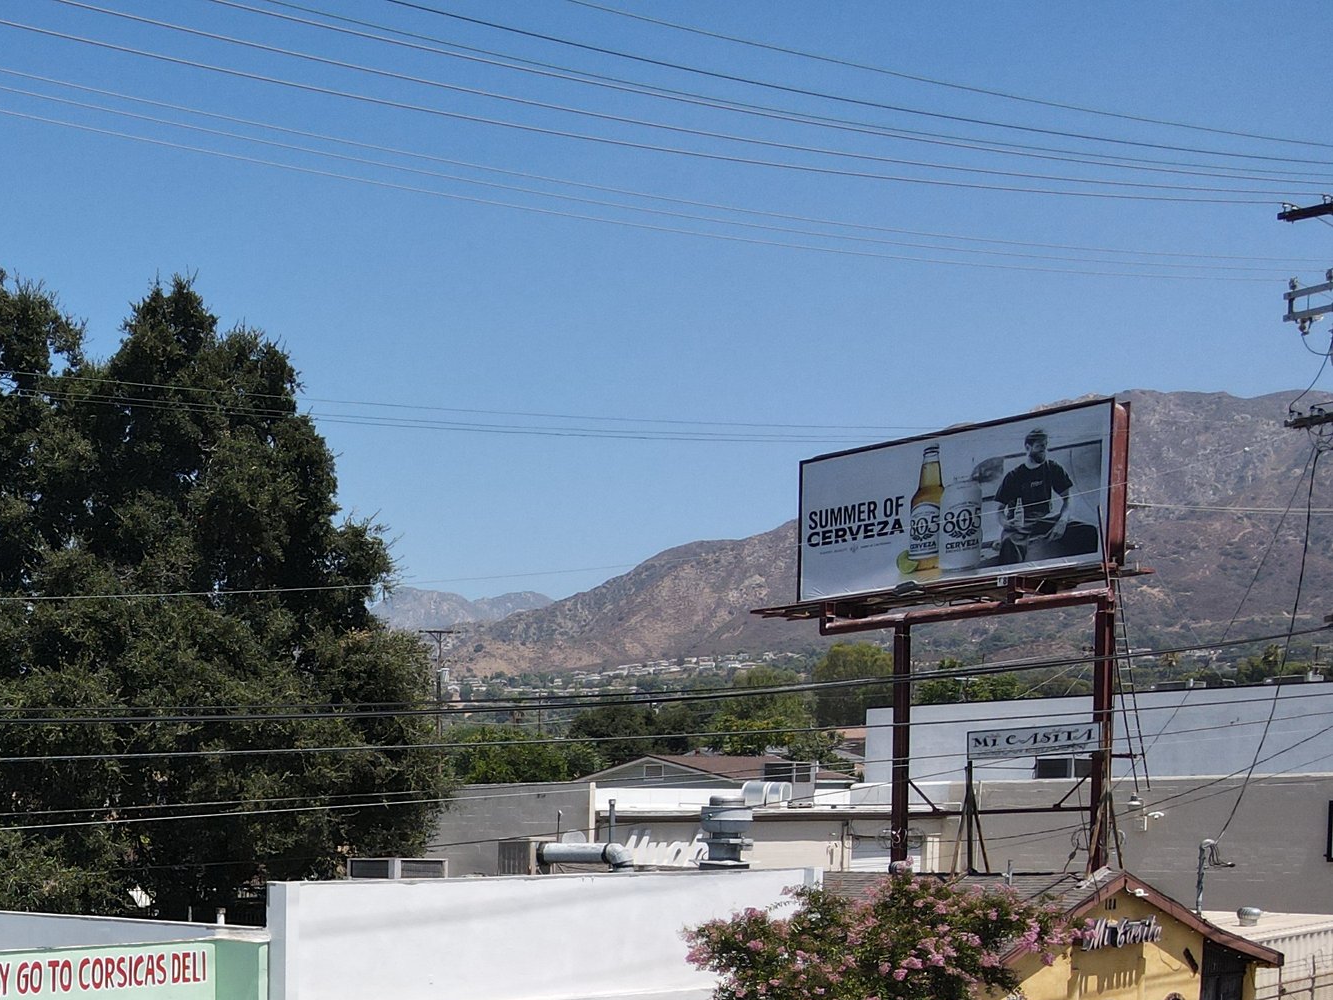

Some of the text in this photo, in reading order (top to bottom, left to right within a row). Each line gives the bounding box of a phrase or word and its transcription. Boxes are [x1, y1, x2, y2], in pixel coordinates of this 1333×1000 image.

[809, 496, 904, 530] SUMMER OF
[910, 515, 940, 536] 805
[943, 507, 982, 534] 805
[807, 518, 904, 547] CERVEZA
[945, 539, 979, 550] CERVEZA
[17, 961, 43, 994] GO
[47, 959, 72, 992] TO
[78, 953, 167, 990] CORSICAS
[171, 950, 207, 984] DELI
